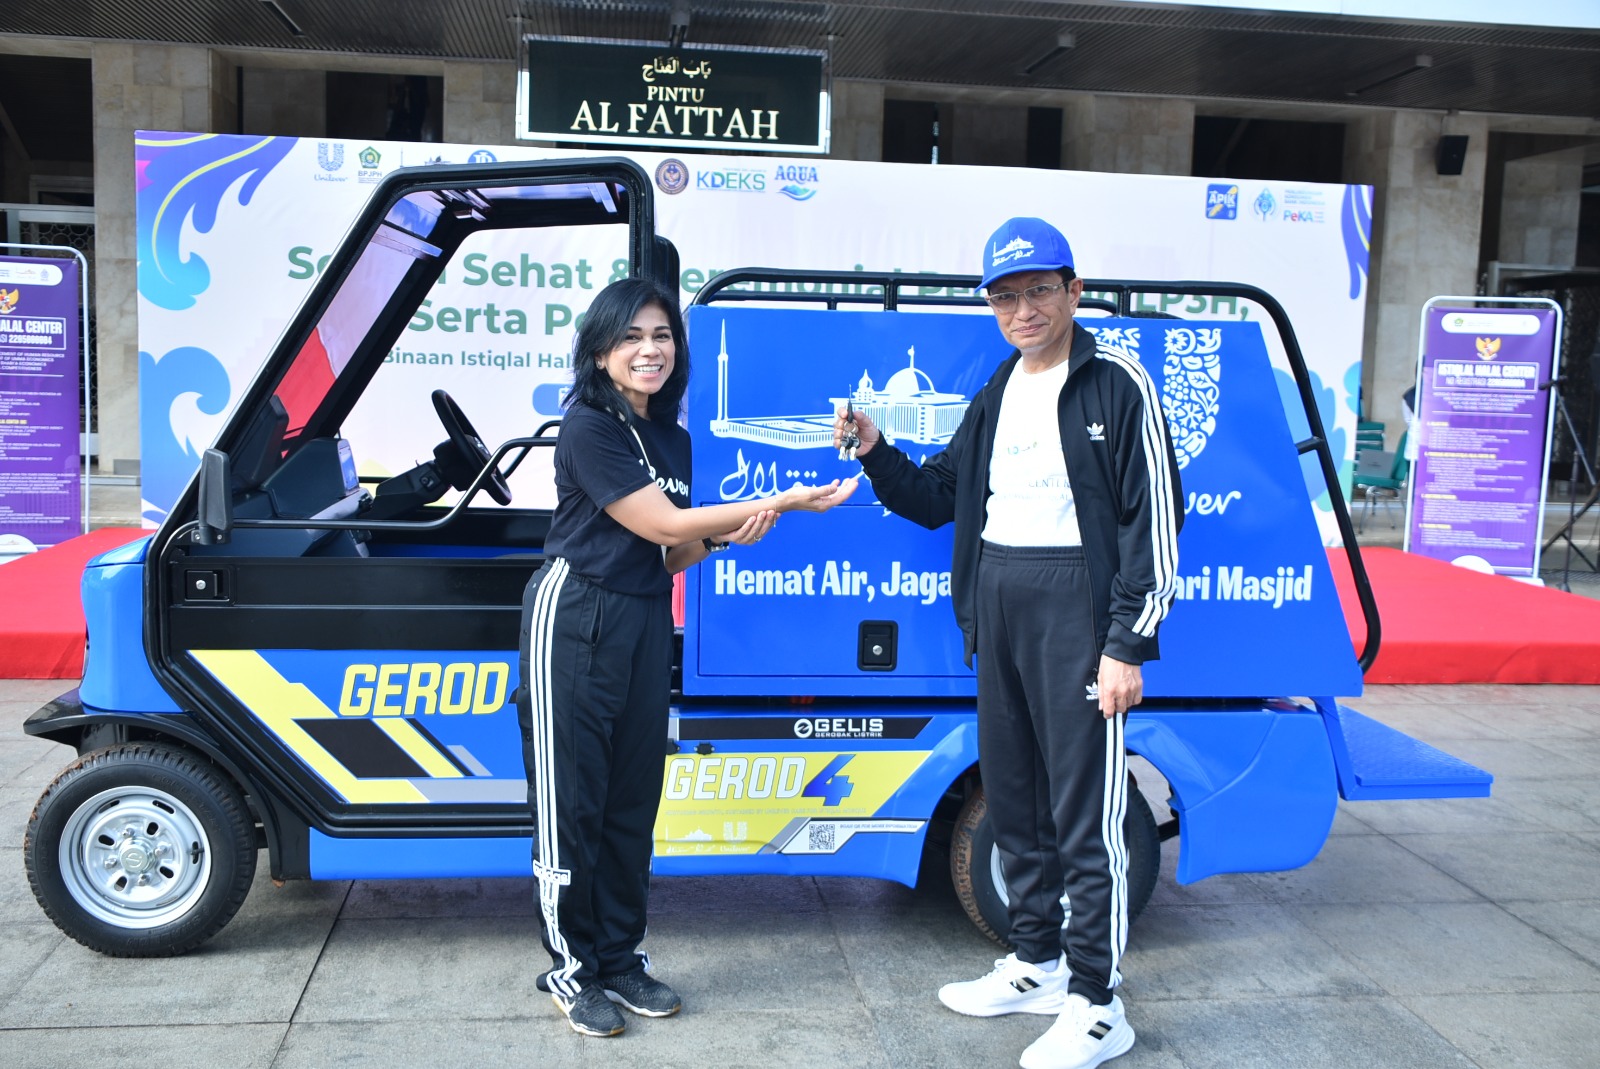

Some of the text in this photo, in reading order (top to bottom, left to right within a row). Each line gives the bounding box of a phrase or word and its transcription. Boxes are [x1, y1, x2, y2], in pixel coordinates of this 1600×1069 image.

[647, 85, 705, 103] PINTU
[570, 99, 780, 140] AL FATTAH
[697, 171, 766, 191] KDEKS
[775, 165, 819, 184] AQUA
[462, 252, 593, 291] Sehat
[0, 319, 63, 335] ALAL CENTER
[407, 300, 527, 335] Serta
[384, 346, 454, 367] Binaan
[460, 350, 532, 370] Istiqlal
[715, 559, 1313, 609] Hemat Air, Jaga ari Masjid
[338, 662, 511, 717] GEROD
[814, 718, 884, 732] GELIS
